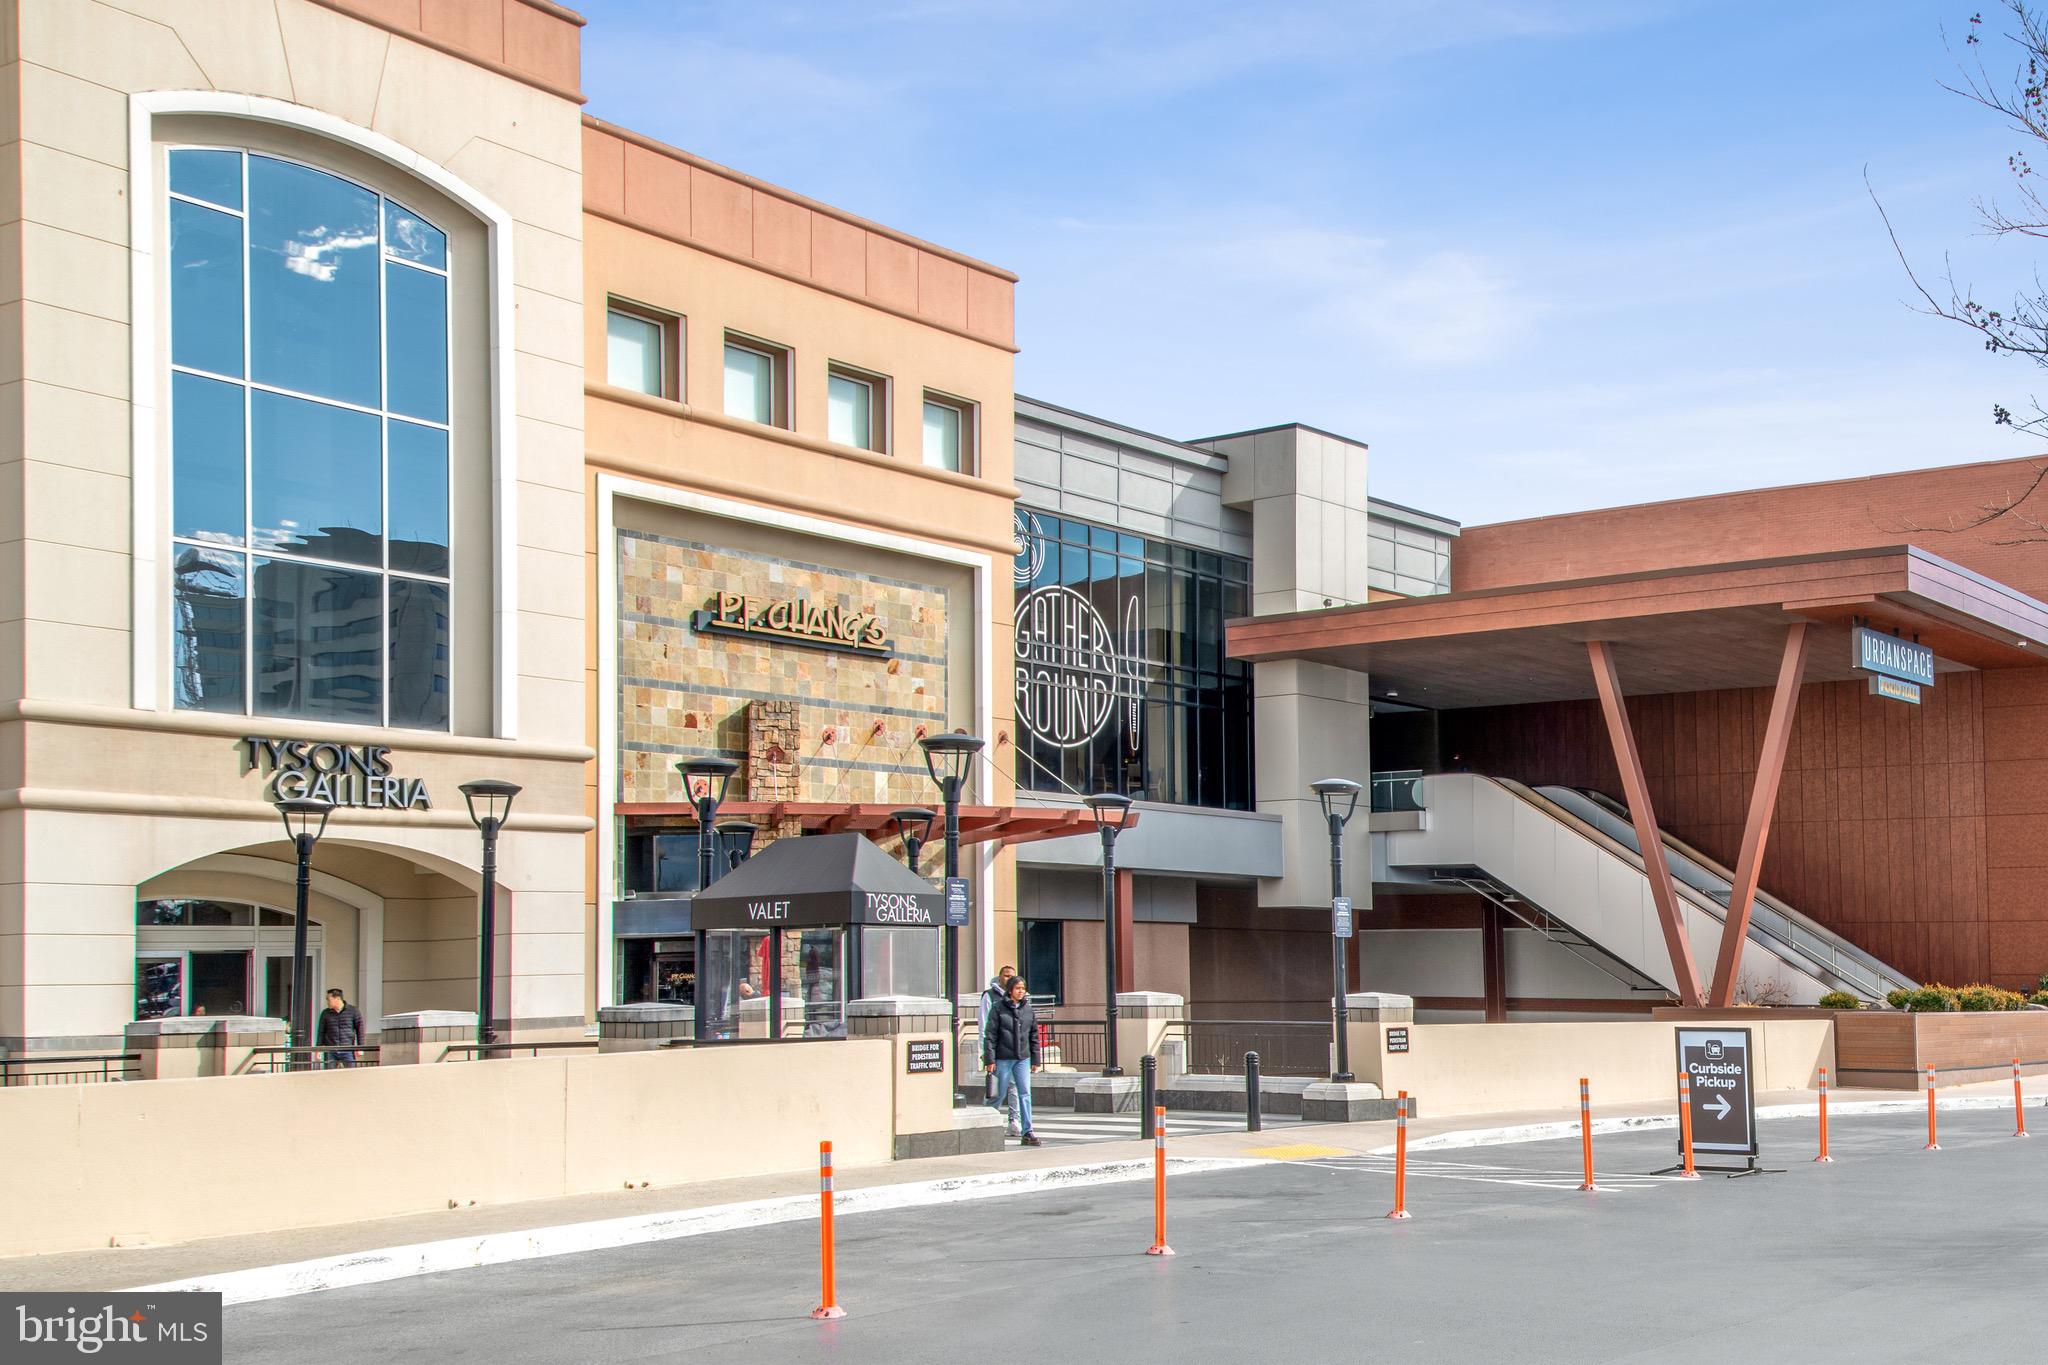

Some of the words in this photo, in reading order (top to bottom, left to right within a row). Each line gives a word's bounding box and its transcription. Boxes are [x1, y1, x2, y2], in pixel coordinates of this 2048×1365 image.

[718, 591, 764, 632] P.F.
[767, 599, 887, 648] CHANG'S
[1014, 592, 1113, 673] GATHER
[1864, 635, 1933, 679] URBANSPACE
[1015, 667, 1107, 741] ROUND
[246, 736, 393, 777] TYSONS
[272, 770, 433, 809] GALLERIA
[748, 901, 790, 920] VALET
[866, 893, 916, 909] TYSONS
[876, 906, 931, 923] GALLERIA
[1689, 1062, 1742, 1075] Curbside
[1696, 1075, 1736, 1090] Pickup
